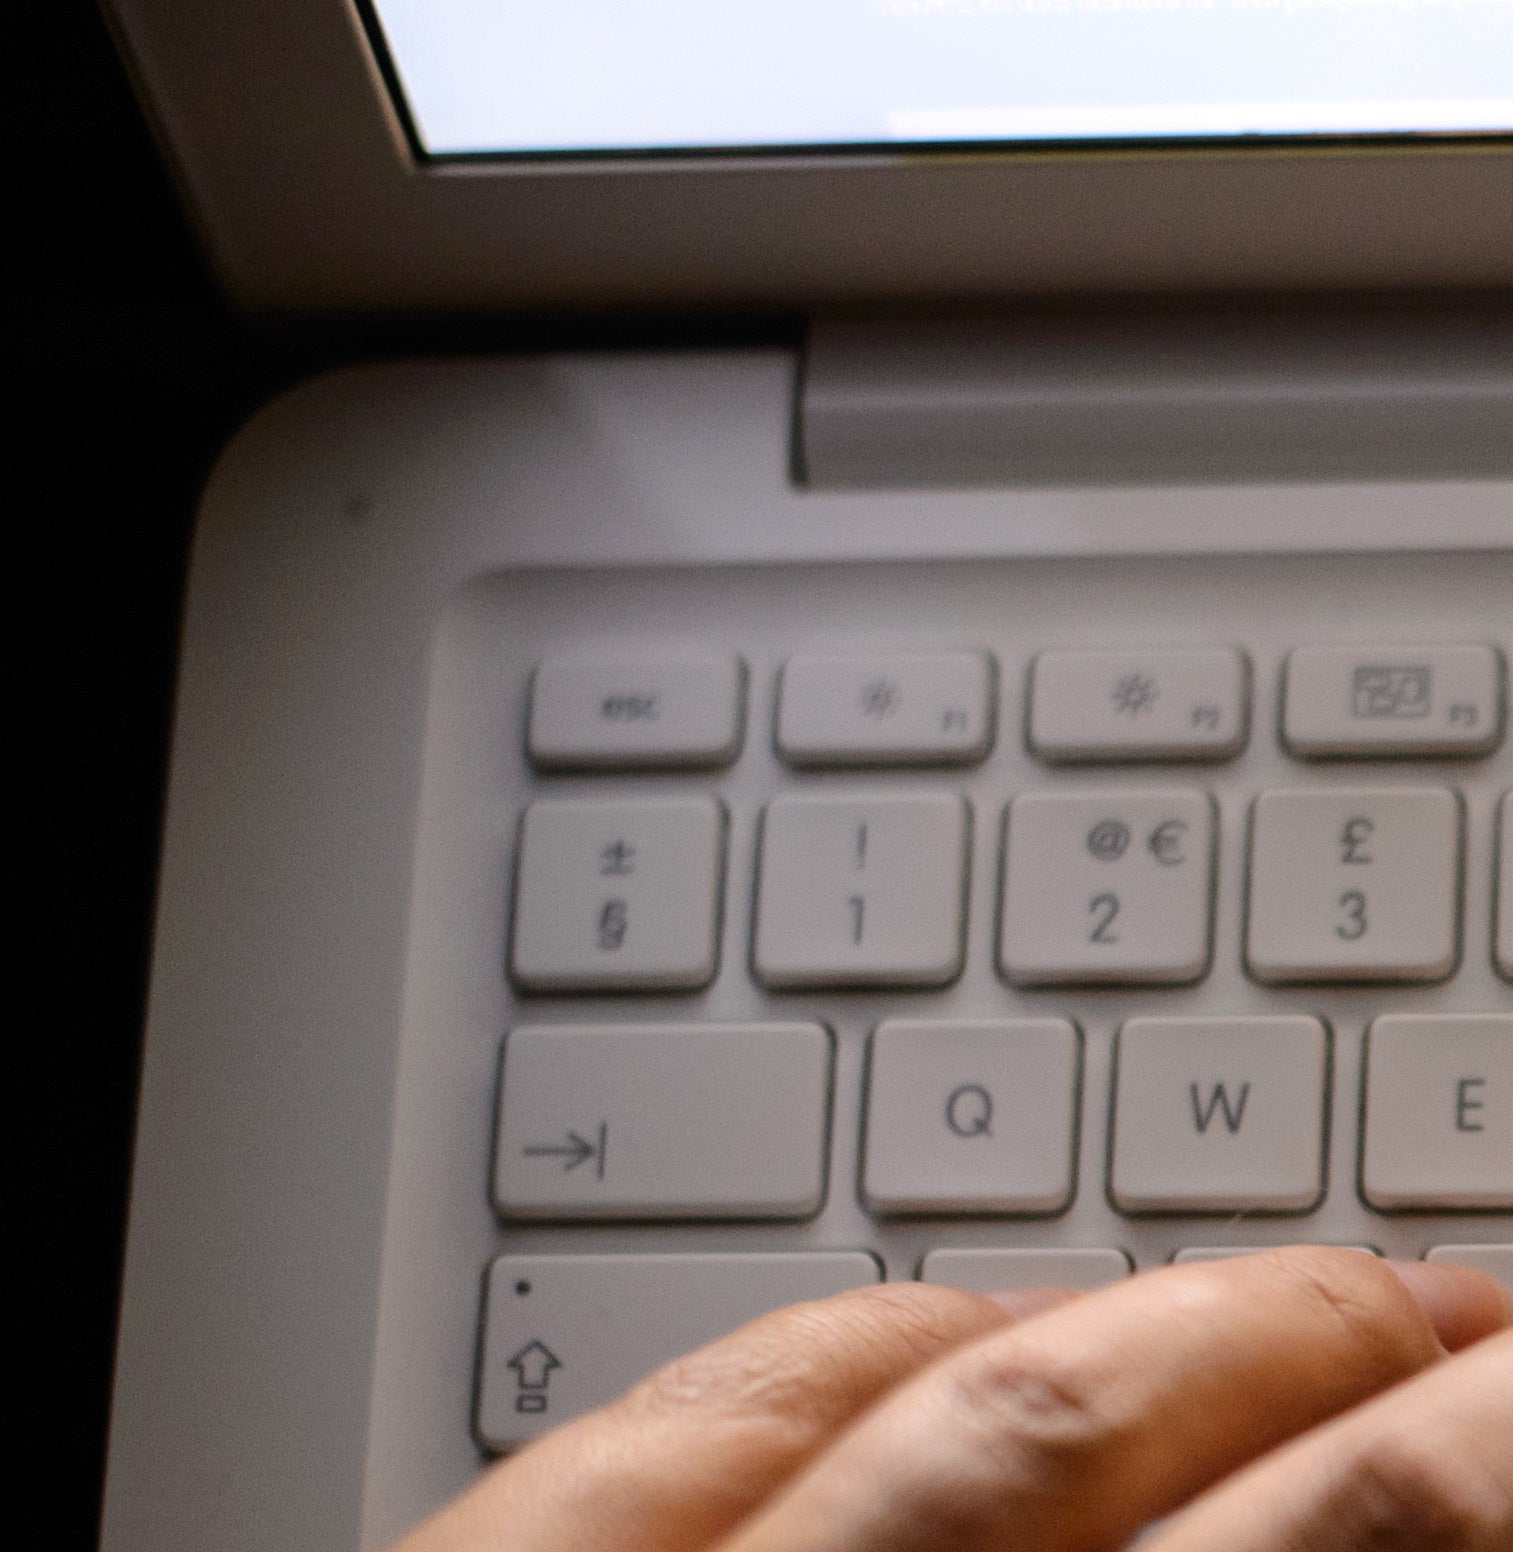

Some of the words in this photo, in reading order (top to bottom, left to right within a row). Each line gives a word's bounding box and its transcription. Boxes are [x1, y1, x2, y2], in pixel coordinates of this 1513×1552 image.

[1447, 702, 1479, 729] F3
[601, 840, 633, 876] ±
[855, 822, 869, 868] !
[1085, 818, 1132, 862] @
[1146, 819, 1186, 866] €
[1339, 815, 1374, 865] £
[847, 894, 866, 945] 1
[1088, 891, 1121, 944] 2
[1335, 888, 1369, 941] 3
[943, 1082, 995, 1139] Q
[1189, 1082, 1250, 1135] W
[1454, 1077, 1485, 1134] E
